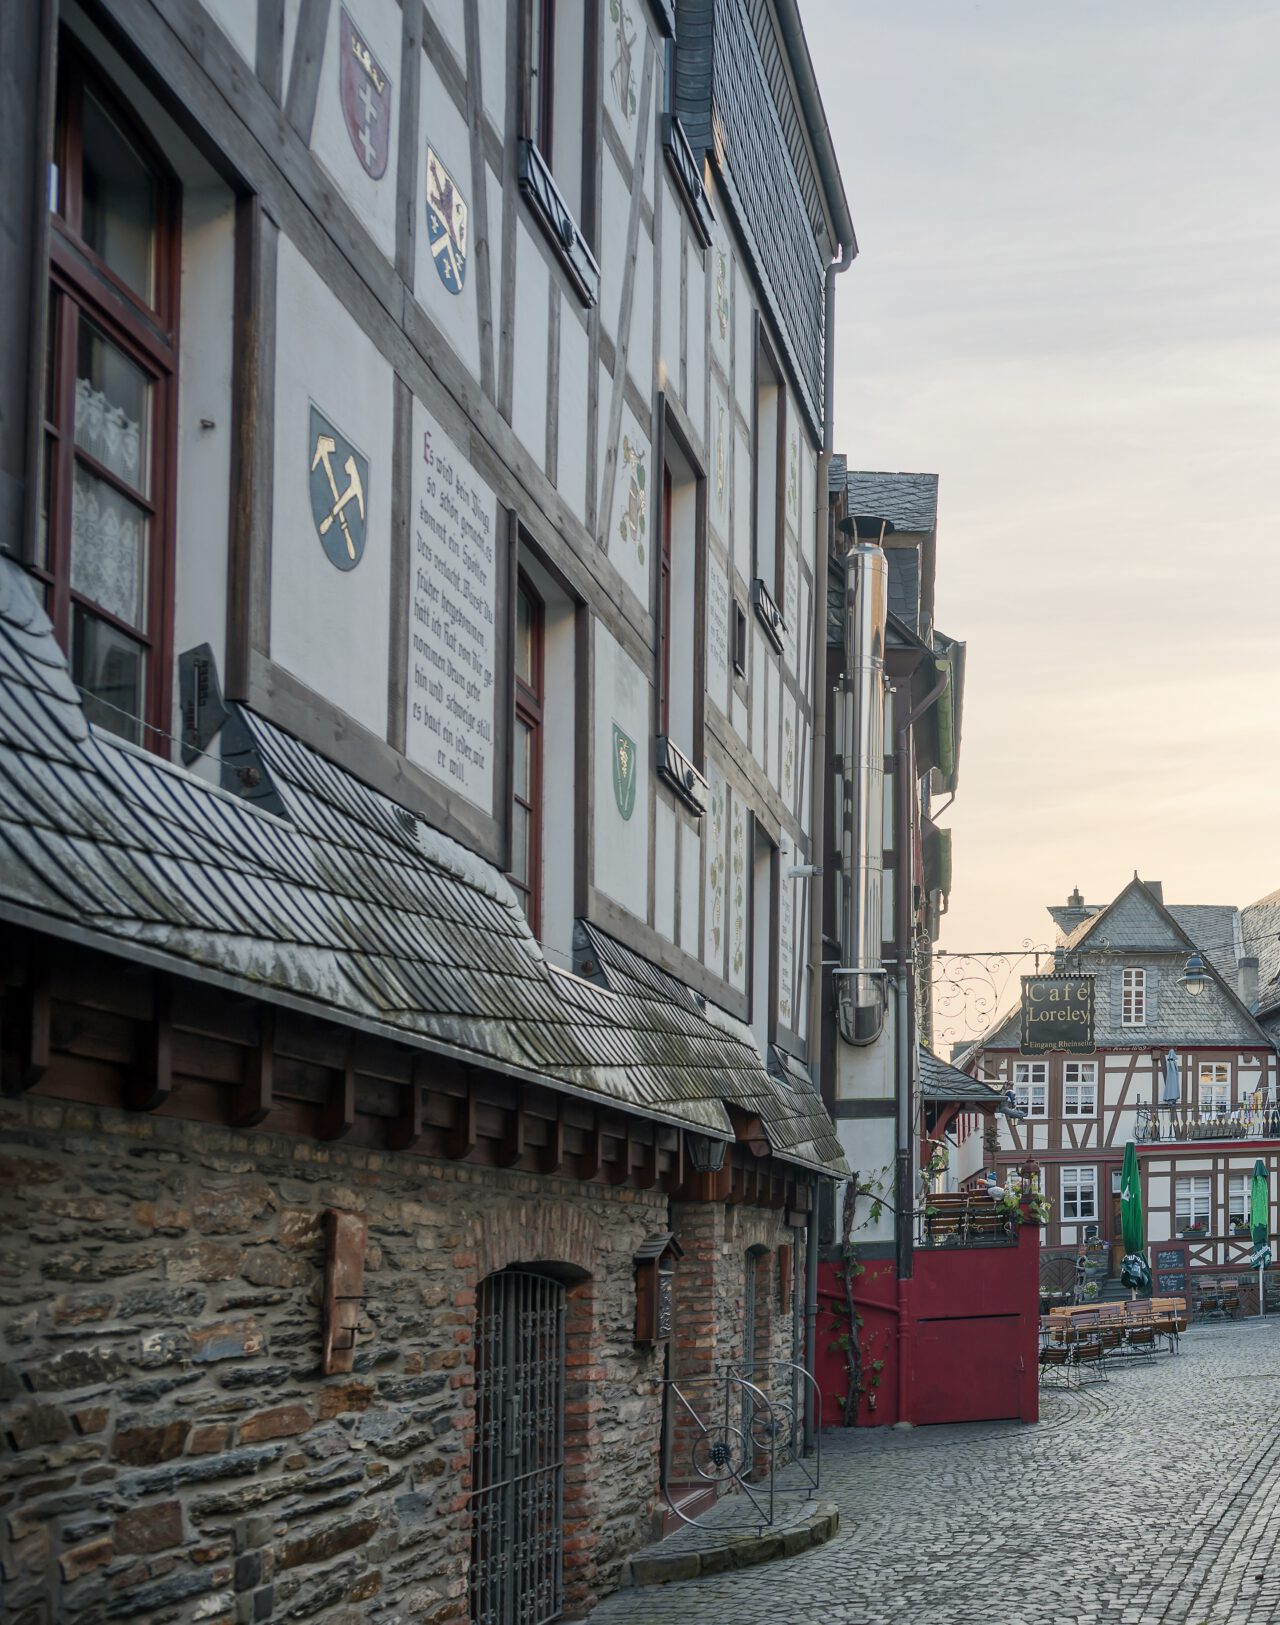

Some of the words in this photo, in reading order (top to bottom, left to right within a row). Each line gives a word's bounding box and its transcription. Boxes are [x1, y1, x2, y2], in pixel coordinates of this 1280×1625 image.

[436, 456, 453, 485] wird
[471, 488, 489, 535] Ding
[449, 531, 460, 558] ein
[415, 663, 428, 692] hin
[429, 680, 443, 704] und
[443, 720, 454, 748] ein
[1029, 982, 1088, 1002] Café
[1028, 1006, 1090, 1024] Loreley
[1029, 1041, 1057, 1050] Eingang
